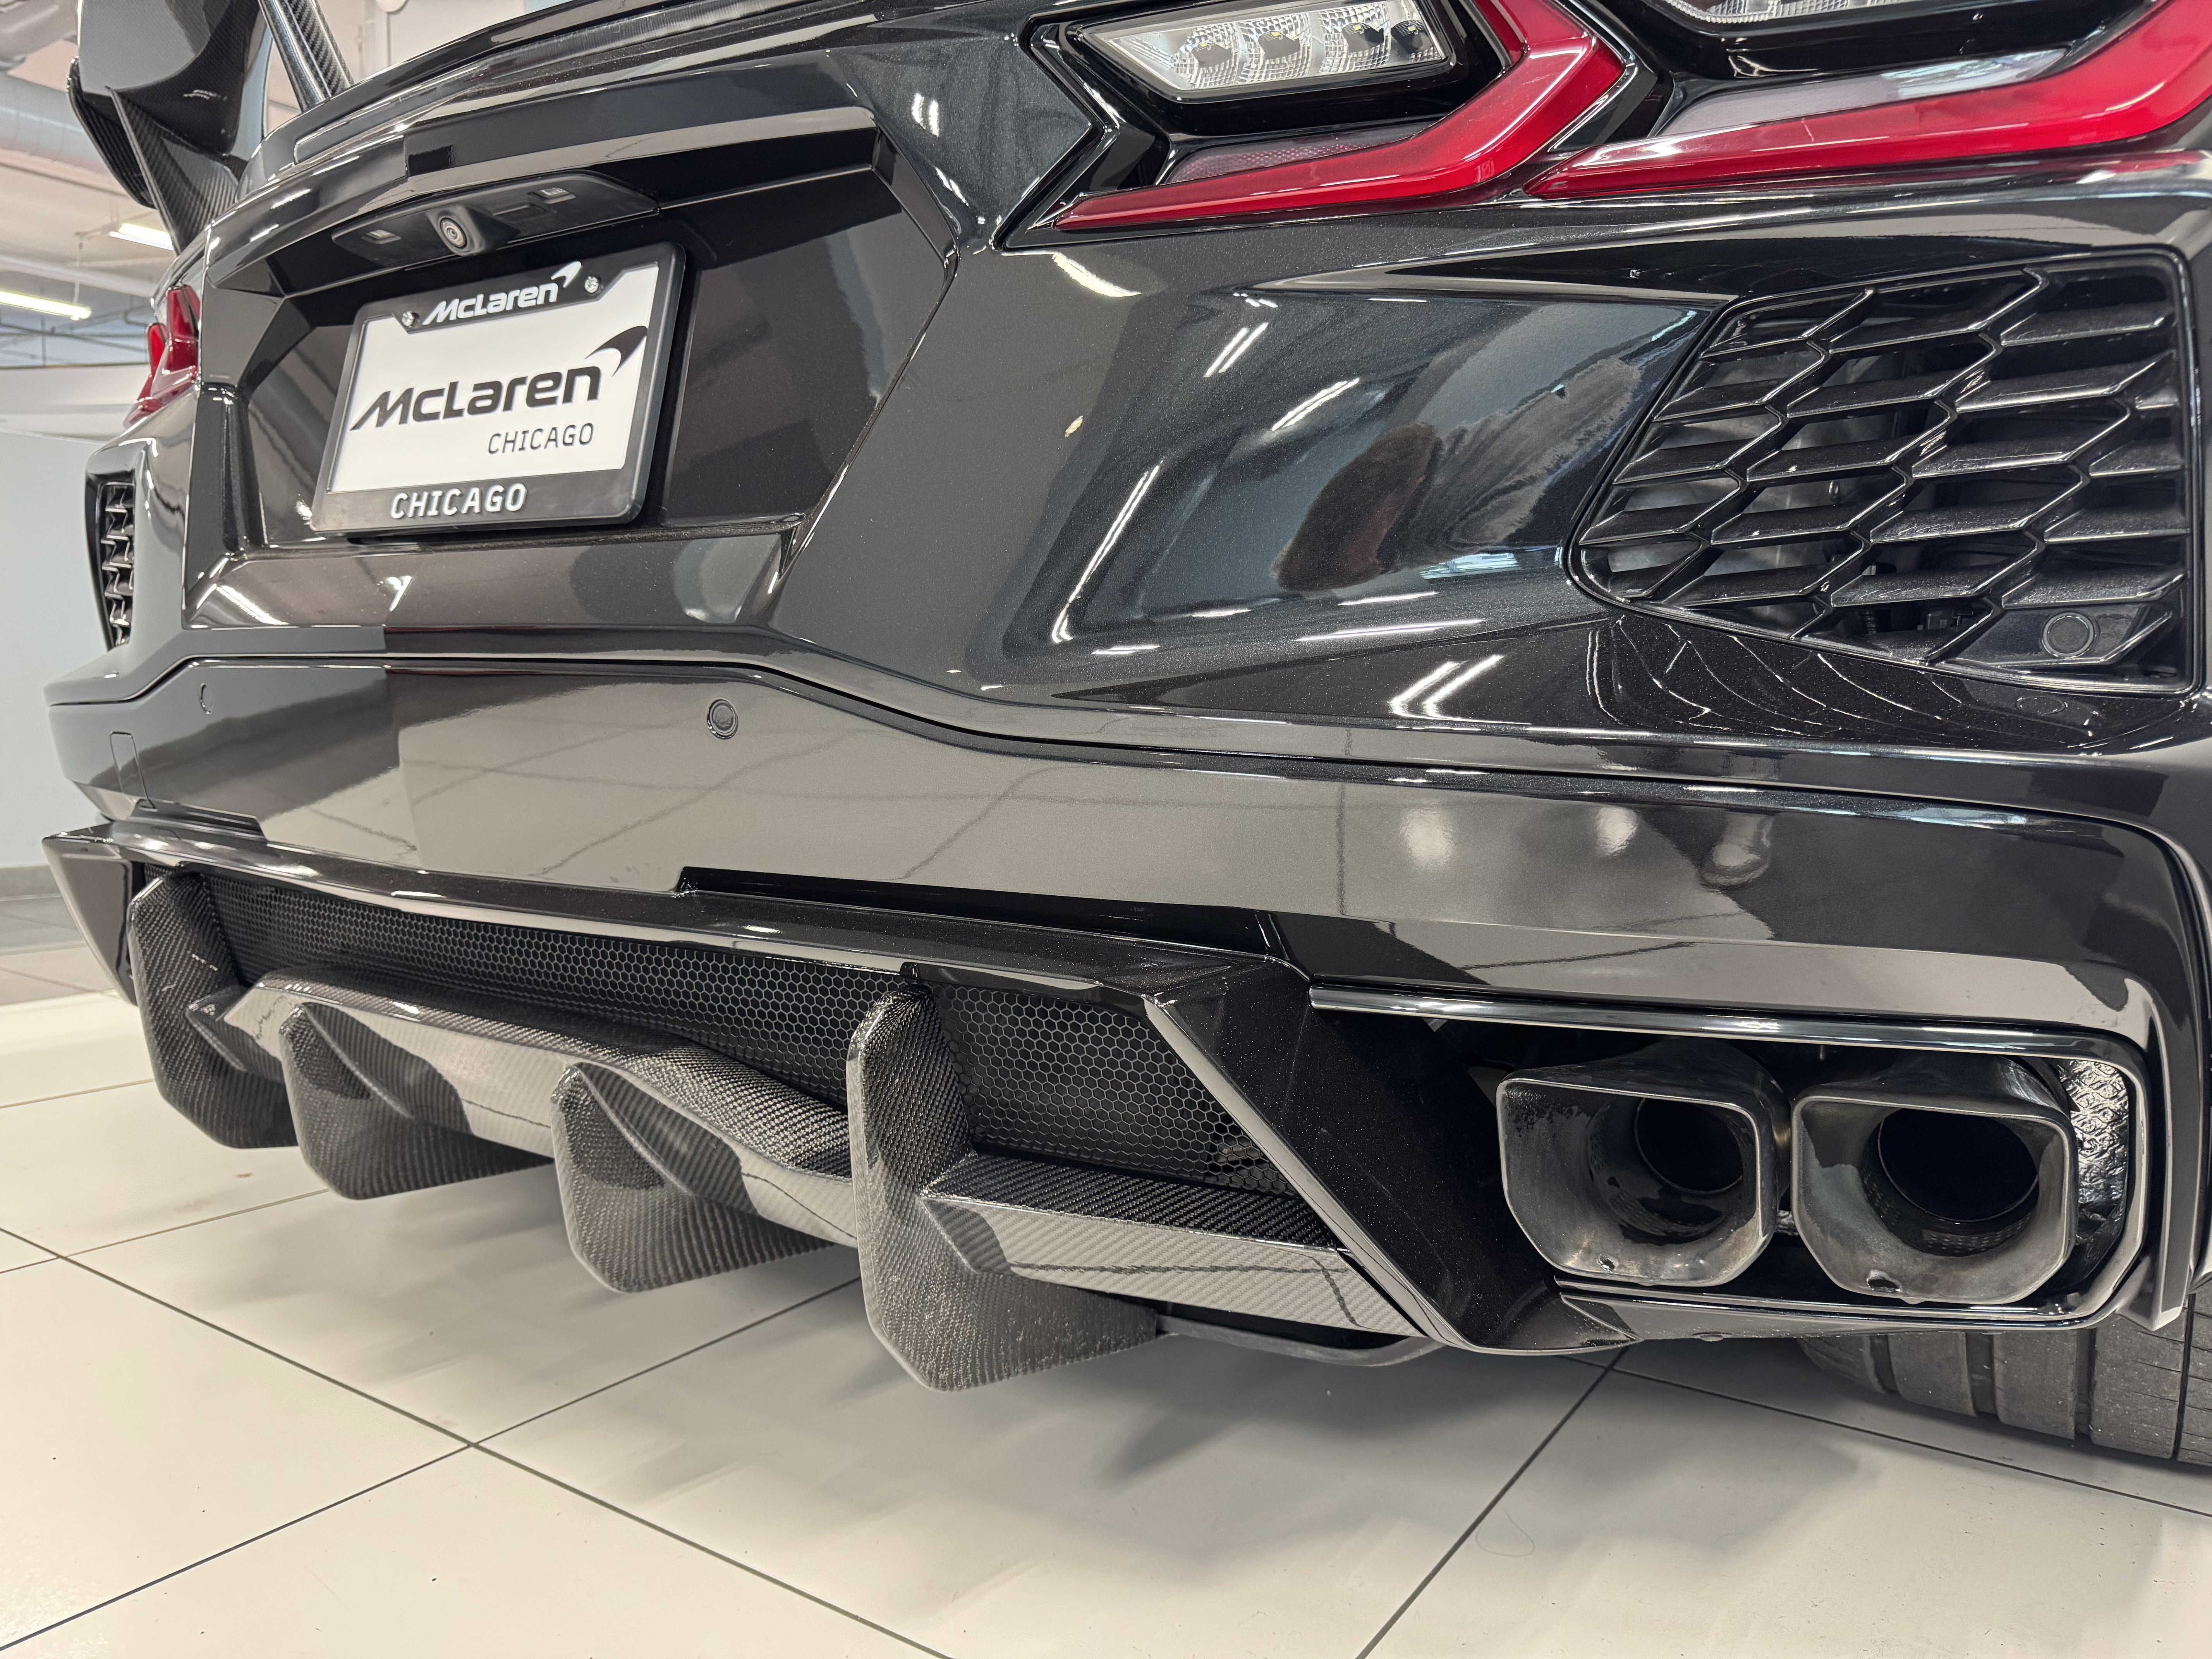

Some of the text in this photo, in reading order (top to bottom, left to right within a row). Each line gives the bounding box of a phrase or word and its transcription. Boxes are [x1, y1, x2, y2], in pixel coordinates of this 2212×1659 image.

[422, 283, 558, 325] McLaren
[349, 366, 602, 431] McLaren
[488, 423, 594, 454] CHICAGO
[390, 483, 527, 519] CHICAGO
